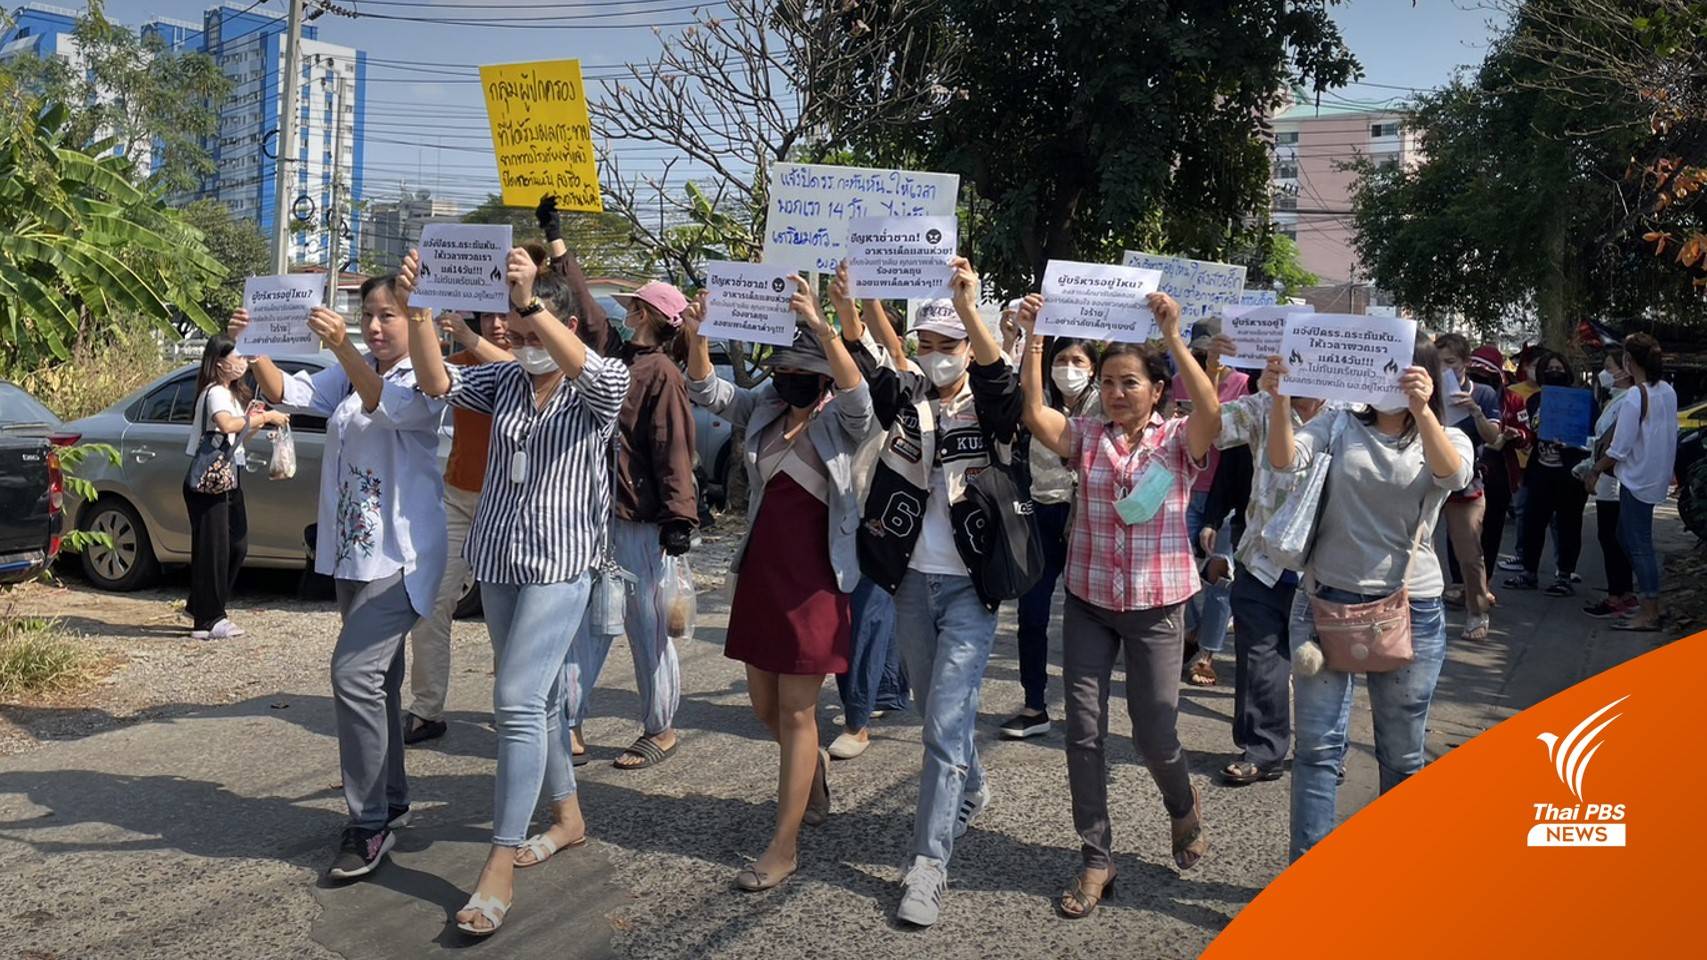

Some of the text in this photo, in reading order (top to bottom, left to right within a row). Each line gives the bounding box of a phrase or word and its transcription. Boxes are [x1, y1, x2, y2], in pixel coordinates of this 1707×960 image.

[489, 70, 576, 113] กลุ่มผู้ปกครอง
[778, 199, 821, 216] พวกเรา
[828, 202, 844, 220] 14
[434, 249, 492, 261] ให้เวลาพวกเรา
[1058, 274, 1143, 290] ผู้บริหารอยู่ไหน?
[252, 288, 313, 304] ผู้บริหารอยู่ไหน?
[1232, 317, 1285, 329] ผู้บริหารอยู่ไ
[1309, 338, 1388, 354] ให้เวลาพวกเรา
[1318, 353, 1374, 367] แค่14วัน!!!
